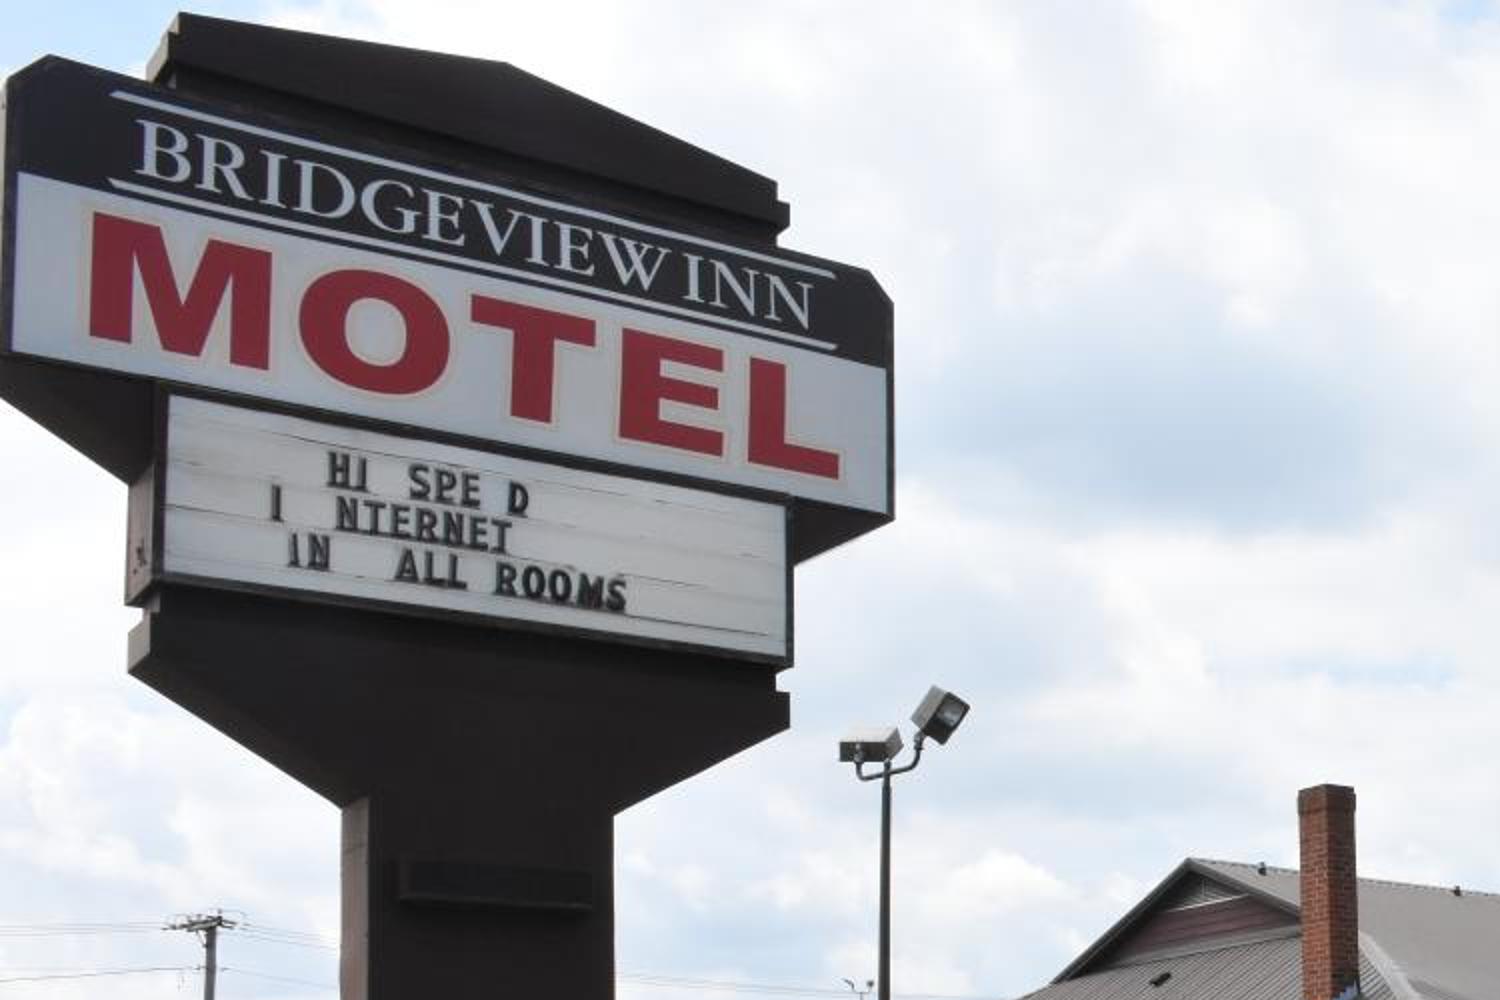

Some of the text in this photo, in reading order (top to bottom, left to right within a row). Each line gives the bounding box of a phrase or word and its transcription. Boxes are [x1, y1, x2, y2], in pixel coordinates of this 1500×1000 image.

[134, 119, 815, 331] BRIDGEVIEW INN
[89, 211, 841, 481] MOTEL
[327, 450, 369, 494] HI
[335, 495, 514, 554] NTERNET
[288, 532, 628, 613] IN ALL ROOMS
